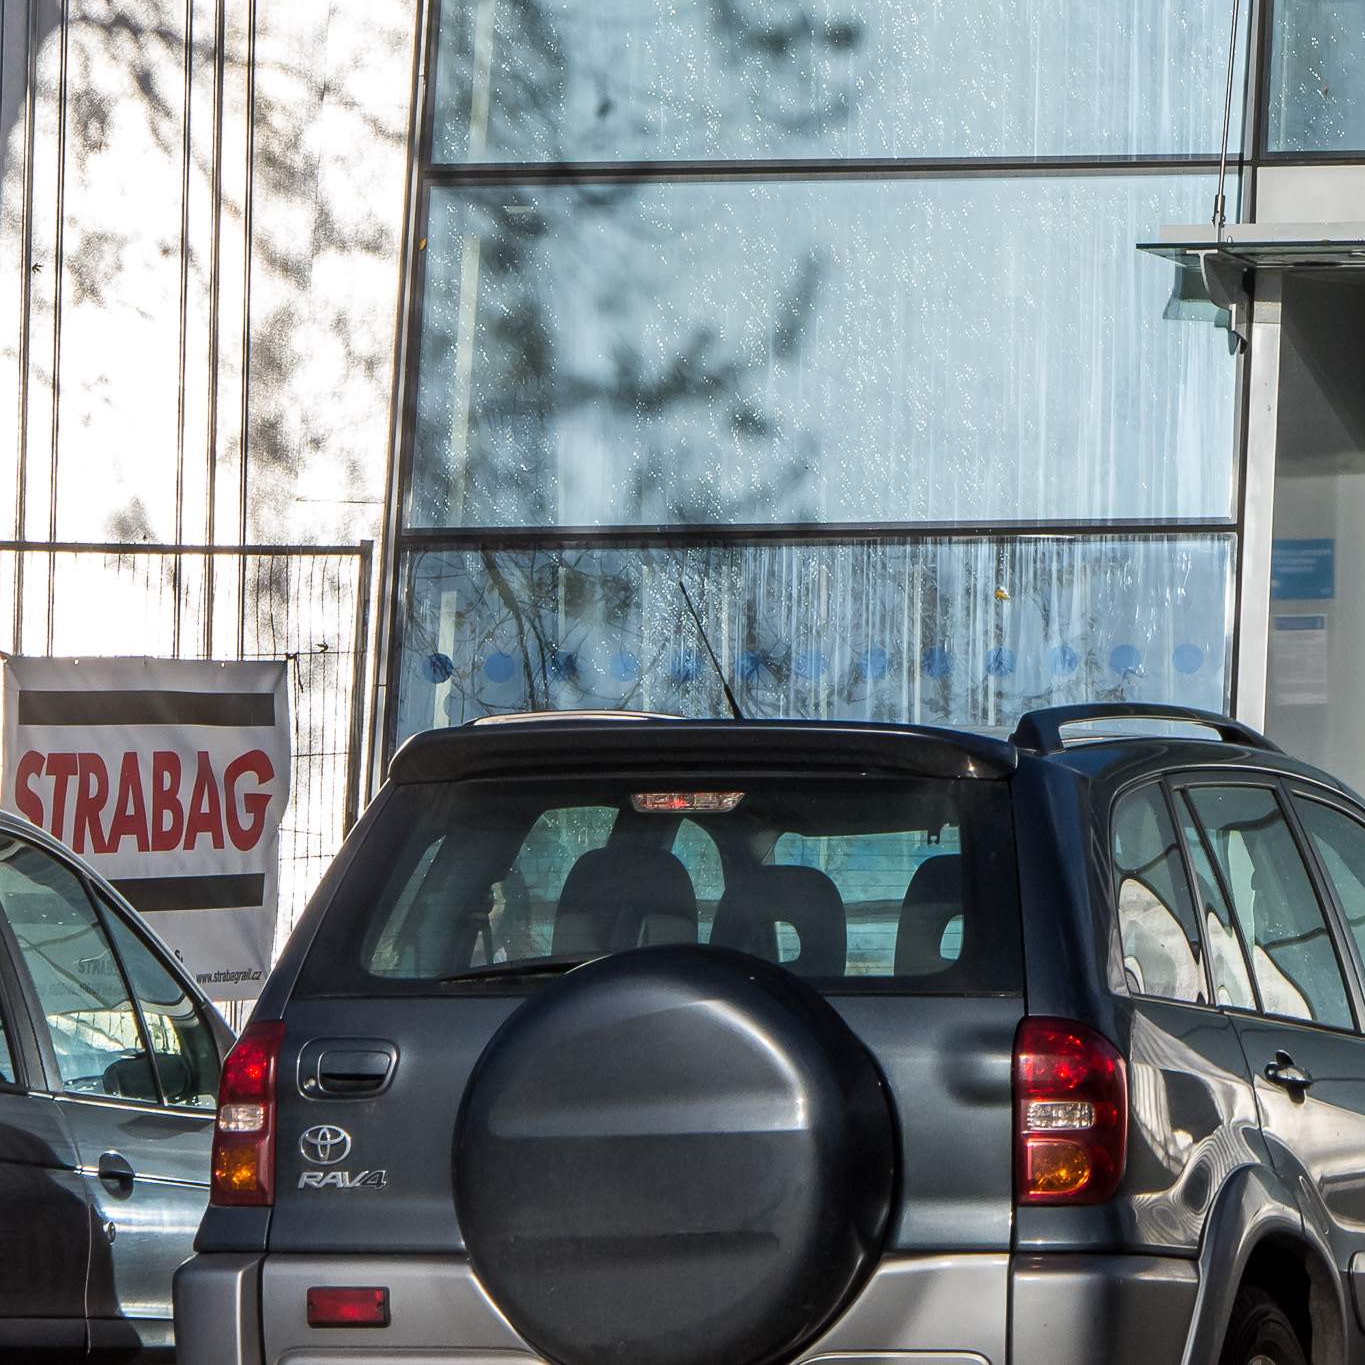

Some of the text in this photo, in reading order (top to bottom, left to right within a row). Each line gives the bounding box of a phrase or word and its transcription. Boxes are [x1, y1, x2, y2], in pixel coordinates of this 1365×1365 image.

[15, 749, 275, 854] STRABAG
[196, 968, 262, 985] www.strabagrail.cz
[297, 1169, 387, 1190] RAV4
